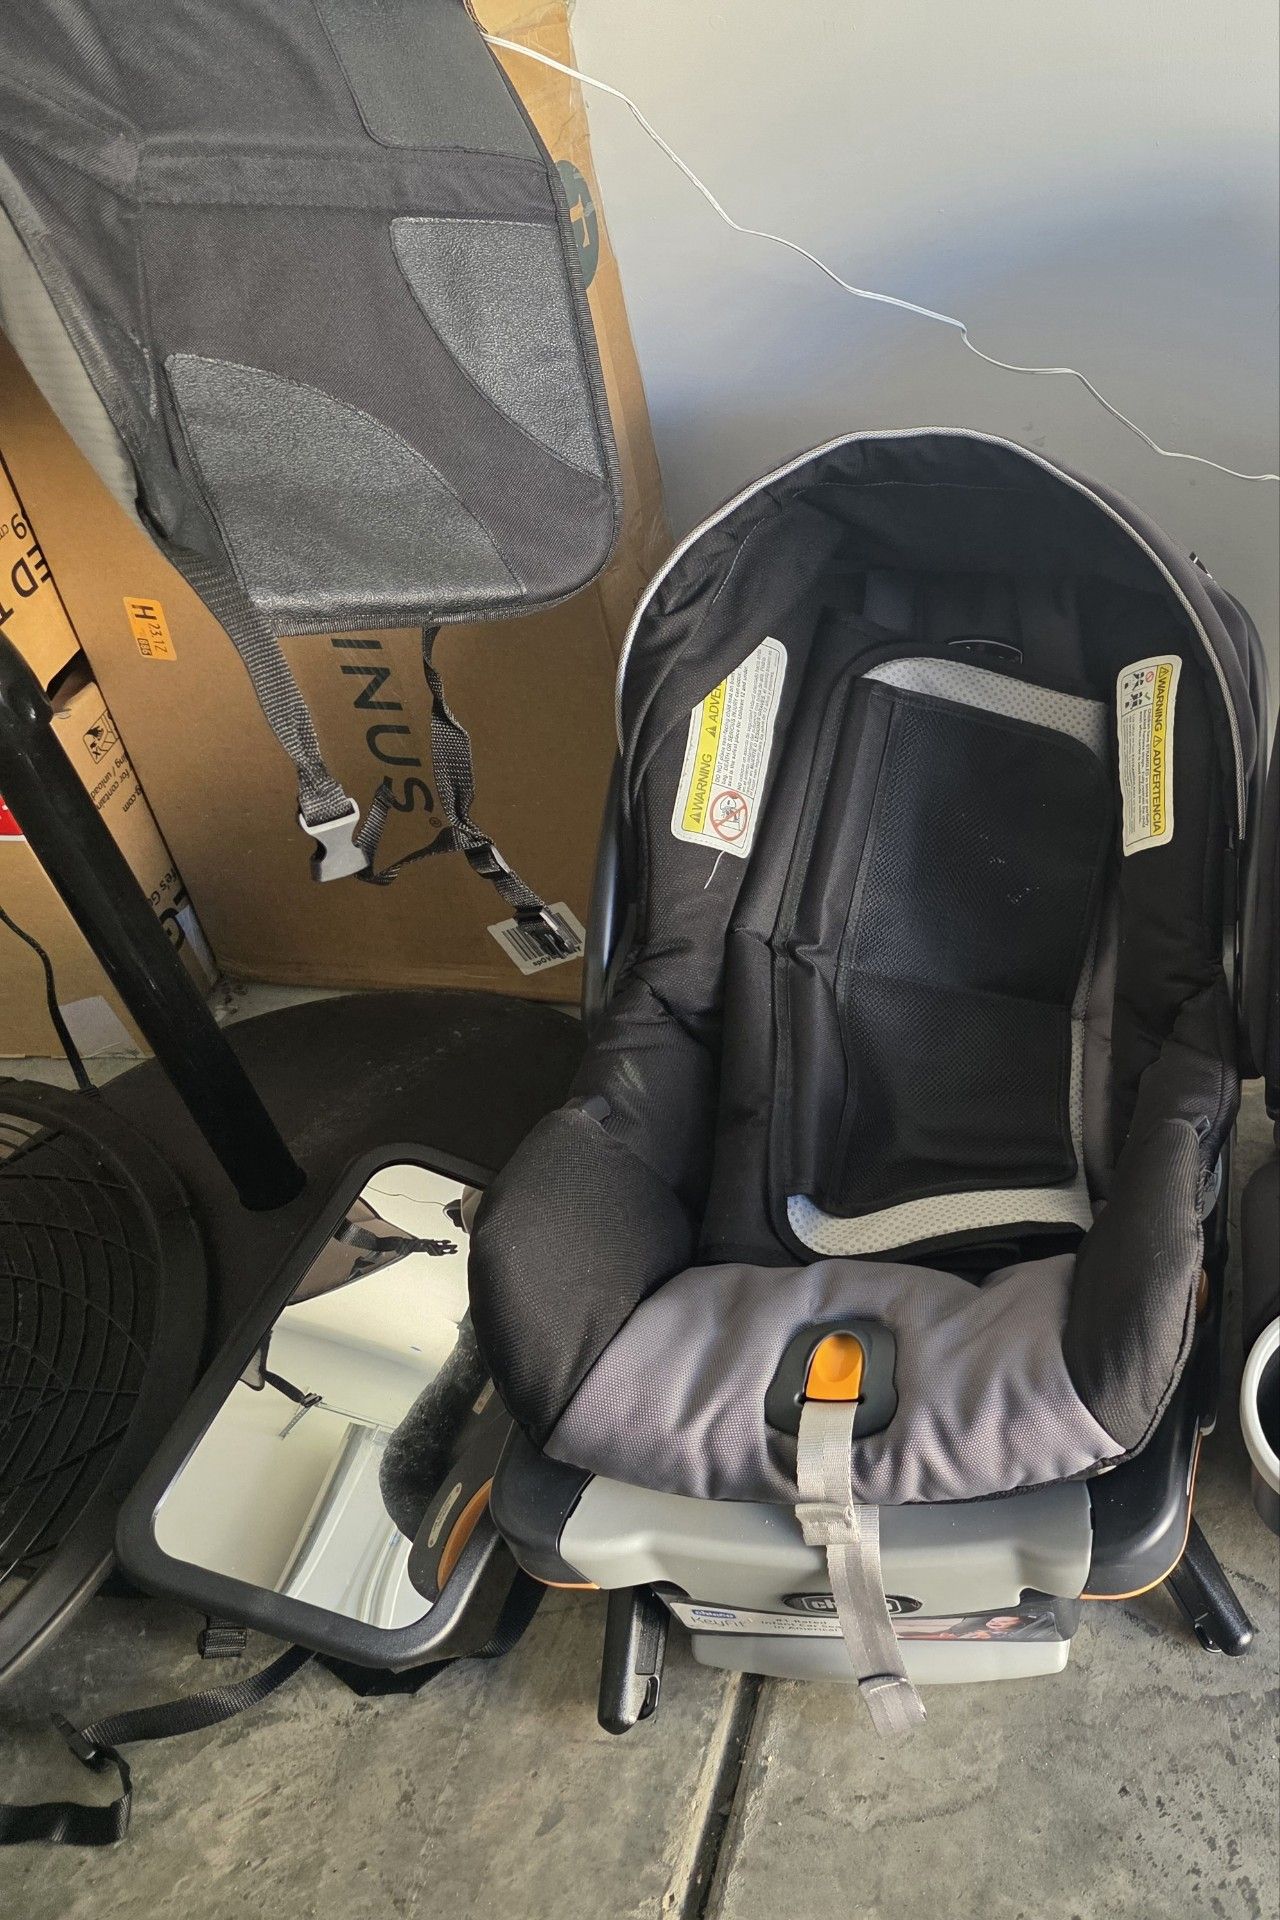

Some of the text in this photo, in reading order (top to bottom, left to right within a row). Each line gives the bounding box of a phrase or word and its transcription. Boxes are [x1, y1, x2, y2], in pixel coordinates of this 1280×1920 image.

[131, 605, 156, 619] H
[692, 688, 721, 811] WARNING ADVE
[1153, 677, 1168, 833] WARNING ADVERTENCIA
